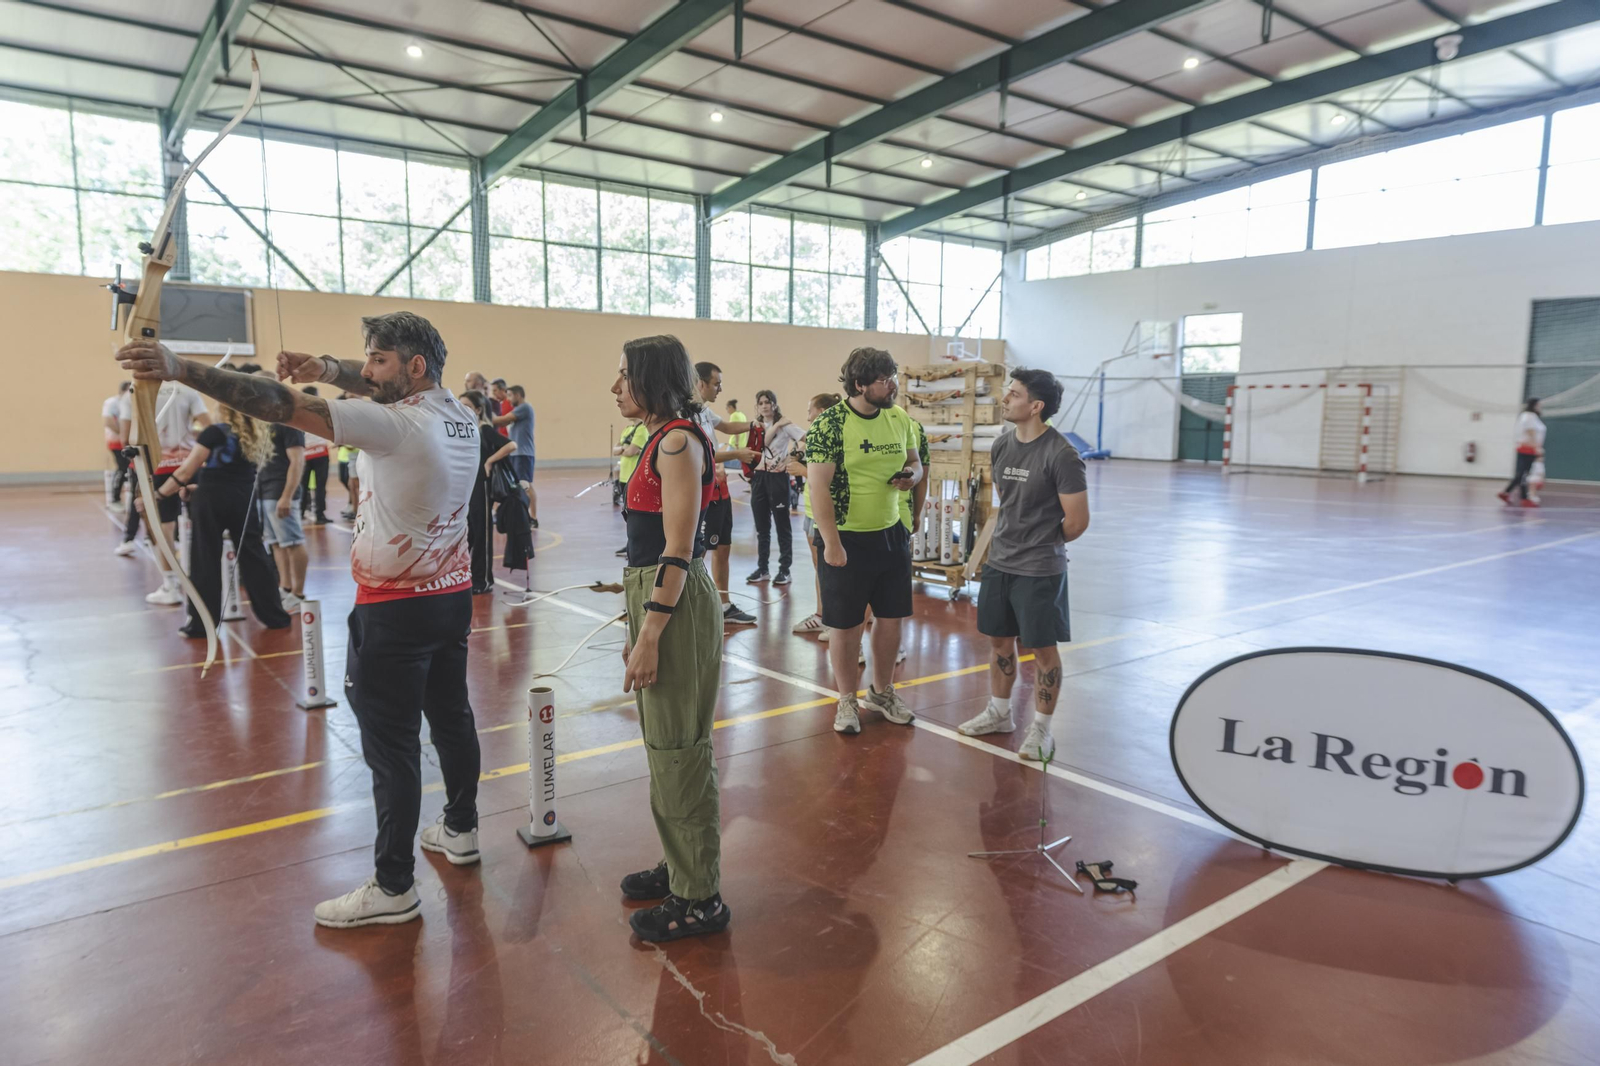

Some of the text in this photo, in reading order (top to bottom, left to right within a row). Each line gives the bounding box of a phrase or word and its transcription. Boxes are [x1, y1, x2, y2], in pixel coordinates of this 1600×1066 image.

[304, 630, 316, 680] LUMELAR
[541, 709, 554, 721] 11
[543, 731, 555, 802] LUMELAR
[1216, 717, 1530, 798] La Región
